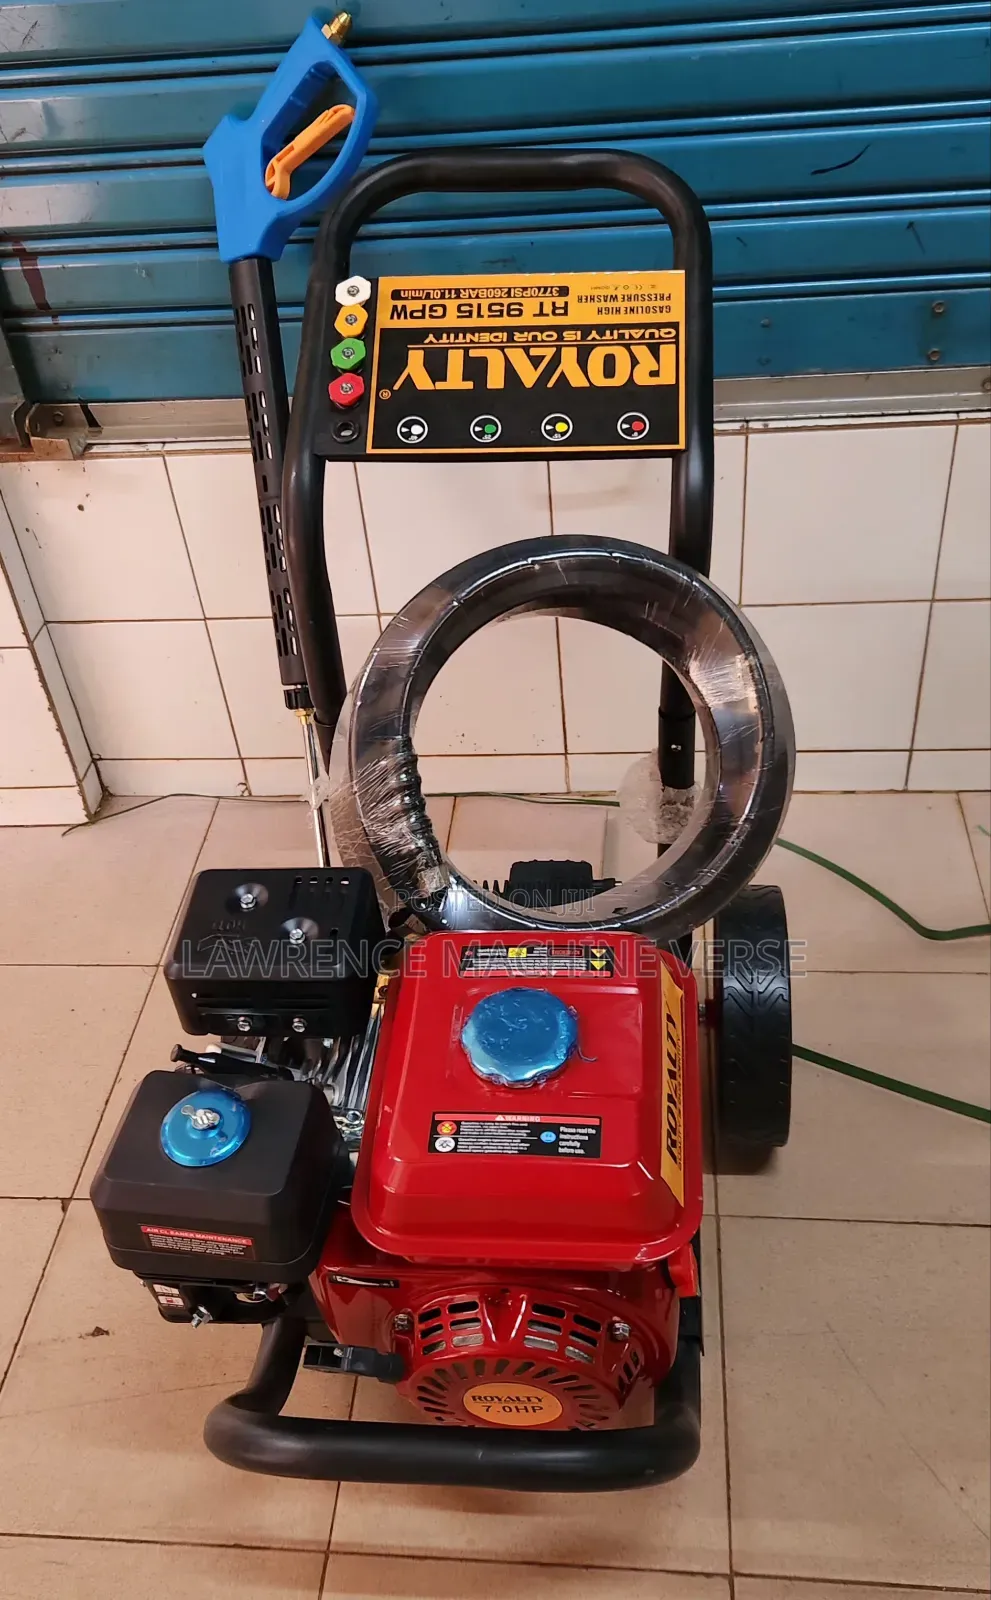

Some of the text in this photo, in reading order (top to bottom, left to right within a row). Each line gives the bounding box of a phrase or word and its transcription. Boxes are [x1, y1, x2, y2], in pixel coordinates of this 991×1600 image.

[400, 287, 560, 300] 3770PSI 260BAR 11.0L/min
[577, 292, 672, 304] PRESSURE WASHER
[389, 301, 570, 321] RT 9515 GPW
[597, 305, 672, 316] GASOLINE HIGH
[423, 328, 677, 344] QUALITY IS OUR IDENTITY
[392, 346, 677, 391] ROYALTY
[665, 1005, 678, 1163] ROYALTY
[504, 1115, 541, 1123] WARNING
[471, 1395, 544, 1403] ROYALTY
[481, 1405, 544, 1413] 7.0HP
